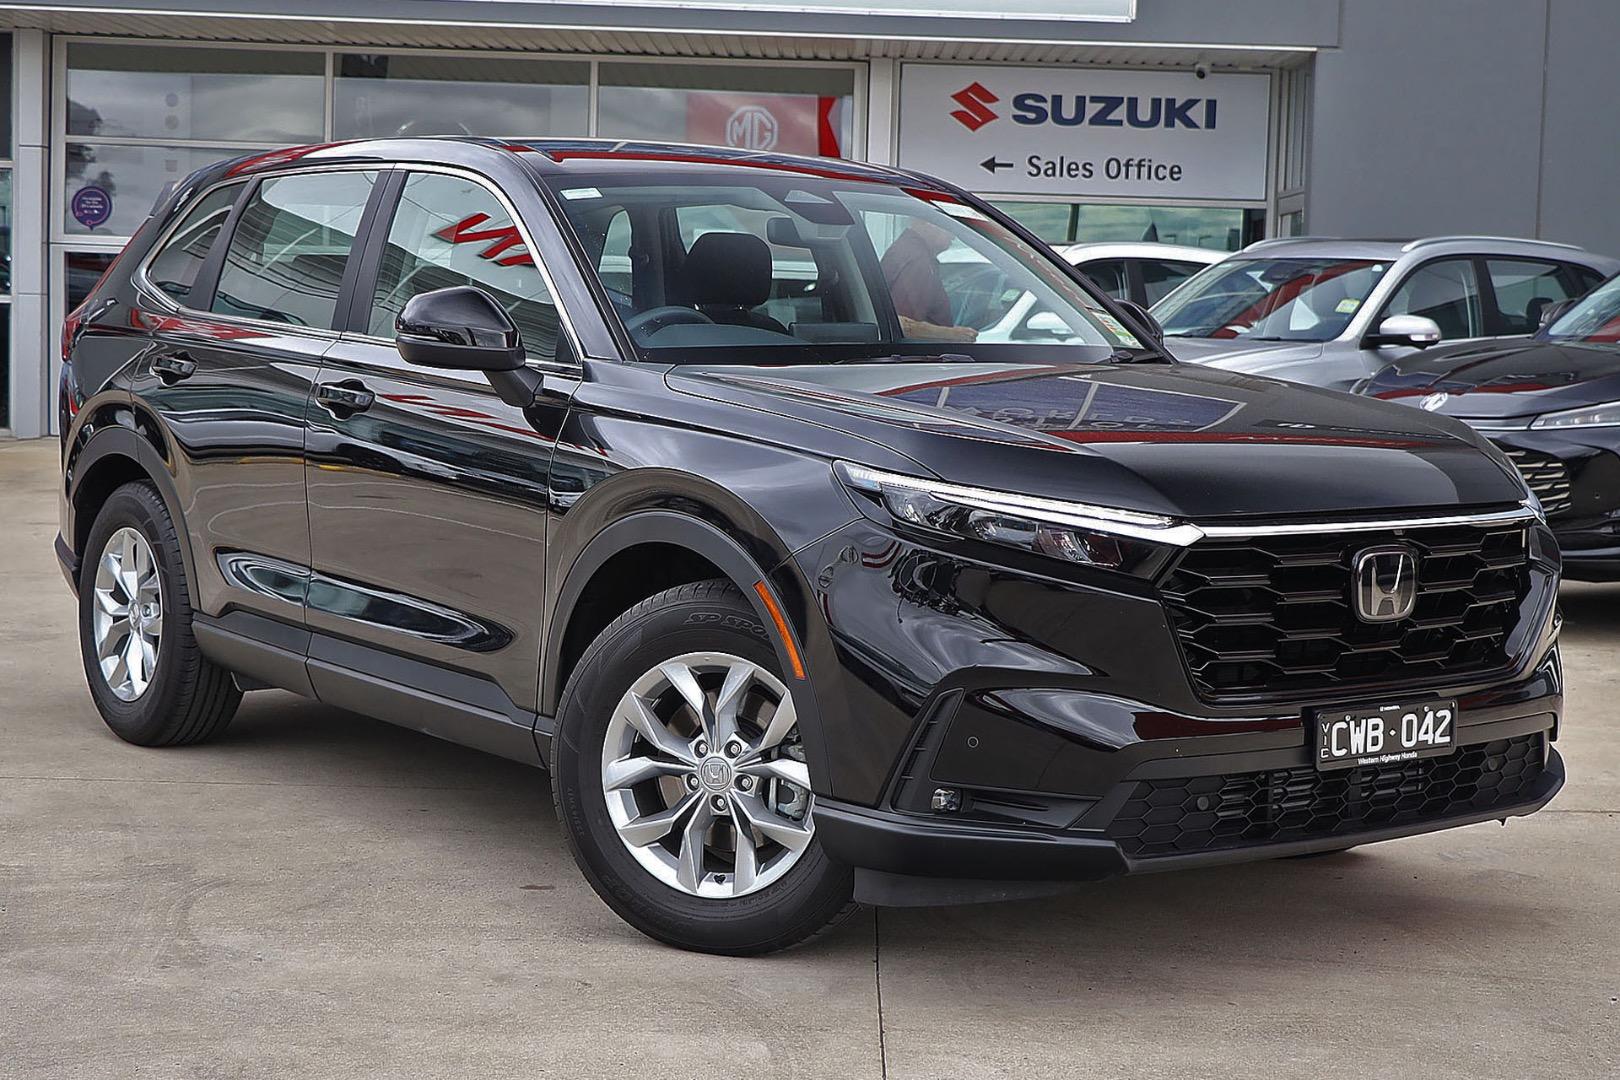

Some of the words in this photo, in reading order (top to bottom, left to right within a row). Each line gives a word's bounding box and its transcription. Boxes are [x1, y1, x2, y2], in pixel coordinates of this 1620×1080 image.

[1012, 93, 1217, 130] SUZUKI
[1027, 155, 1094, 179] Sales
[1104, 157, 1183, 181] Office
[1321, 722, 1330, 758] VIC
[1331, 717, 1384, 756] CWB
[1401, 709, 1451, 748] 042
